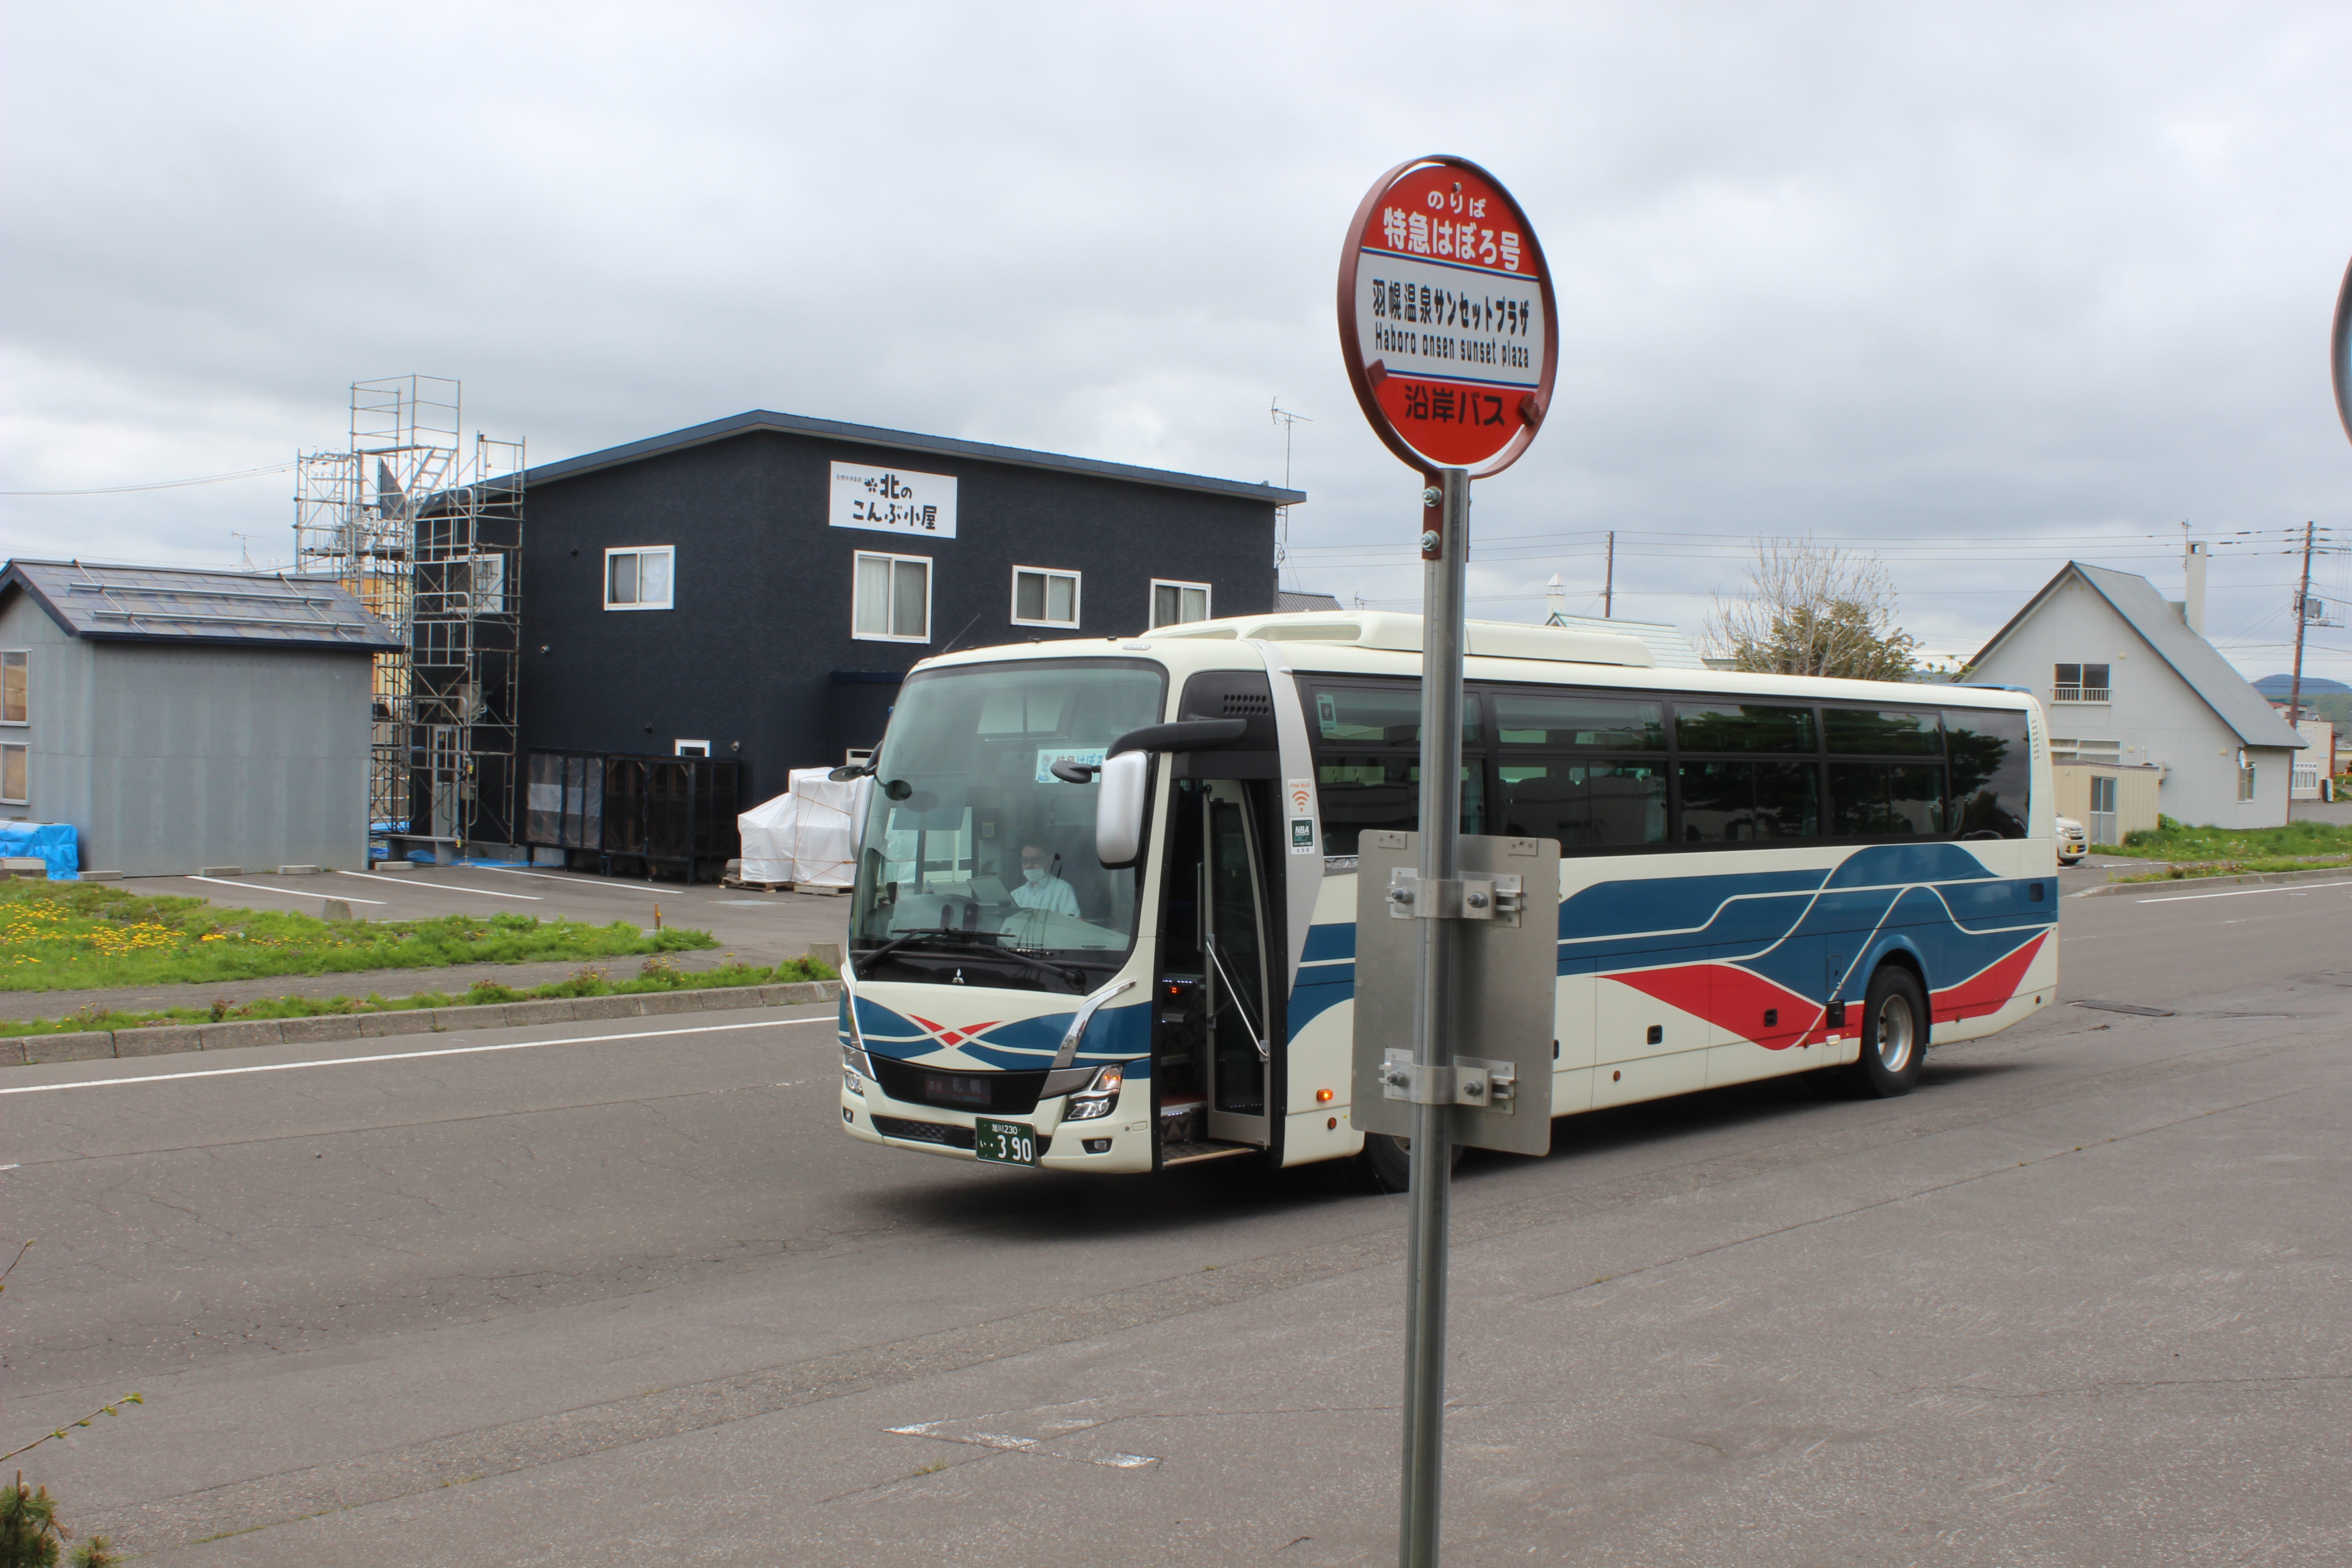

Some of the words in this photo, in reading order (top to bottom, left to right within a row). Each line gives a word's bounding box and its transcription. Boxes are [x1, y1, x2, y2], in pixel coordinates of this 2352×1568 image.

[1427, 191, 1486, 218] のりば
[1383, 206, 1520, 271] 特急はぼろ号
[1373, 279, 1529, 337] 羽幌温泉サンセットプラザ
[1376, 321, 1416, 355] Haboro
[1423, 334, 1455, 360] onsen
[1460, 338, 1496, 365] sunset
[1502, 339, 1529, 368] plaza
[1405, 384, 1505, 426] 沿岸バス
[879, 473, 913, 500] 北の
[852, 500, 937, 530] こんぶ小屋
[1295, 825, 1309, 834] NBA
[952, 1077, 981, 1094] 札幌
[991, 1123, 1018, 1135] 旭川230
